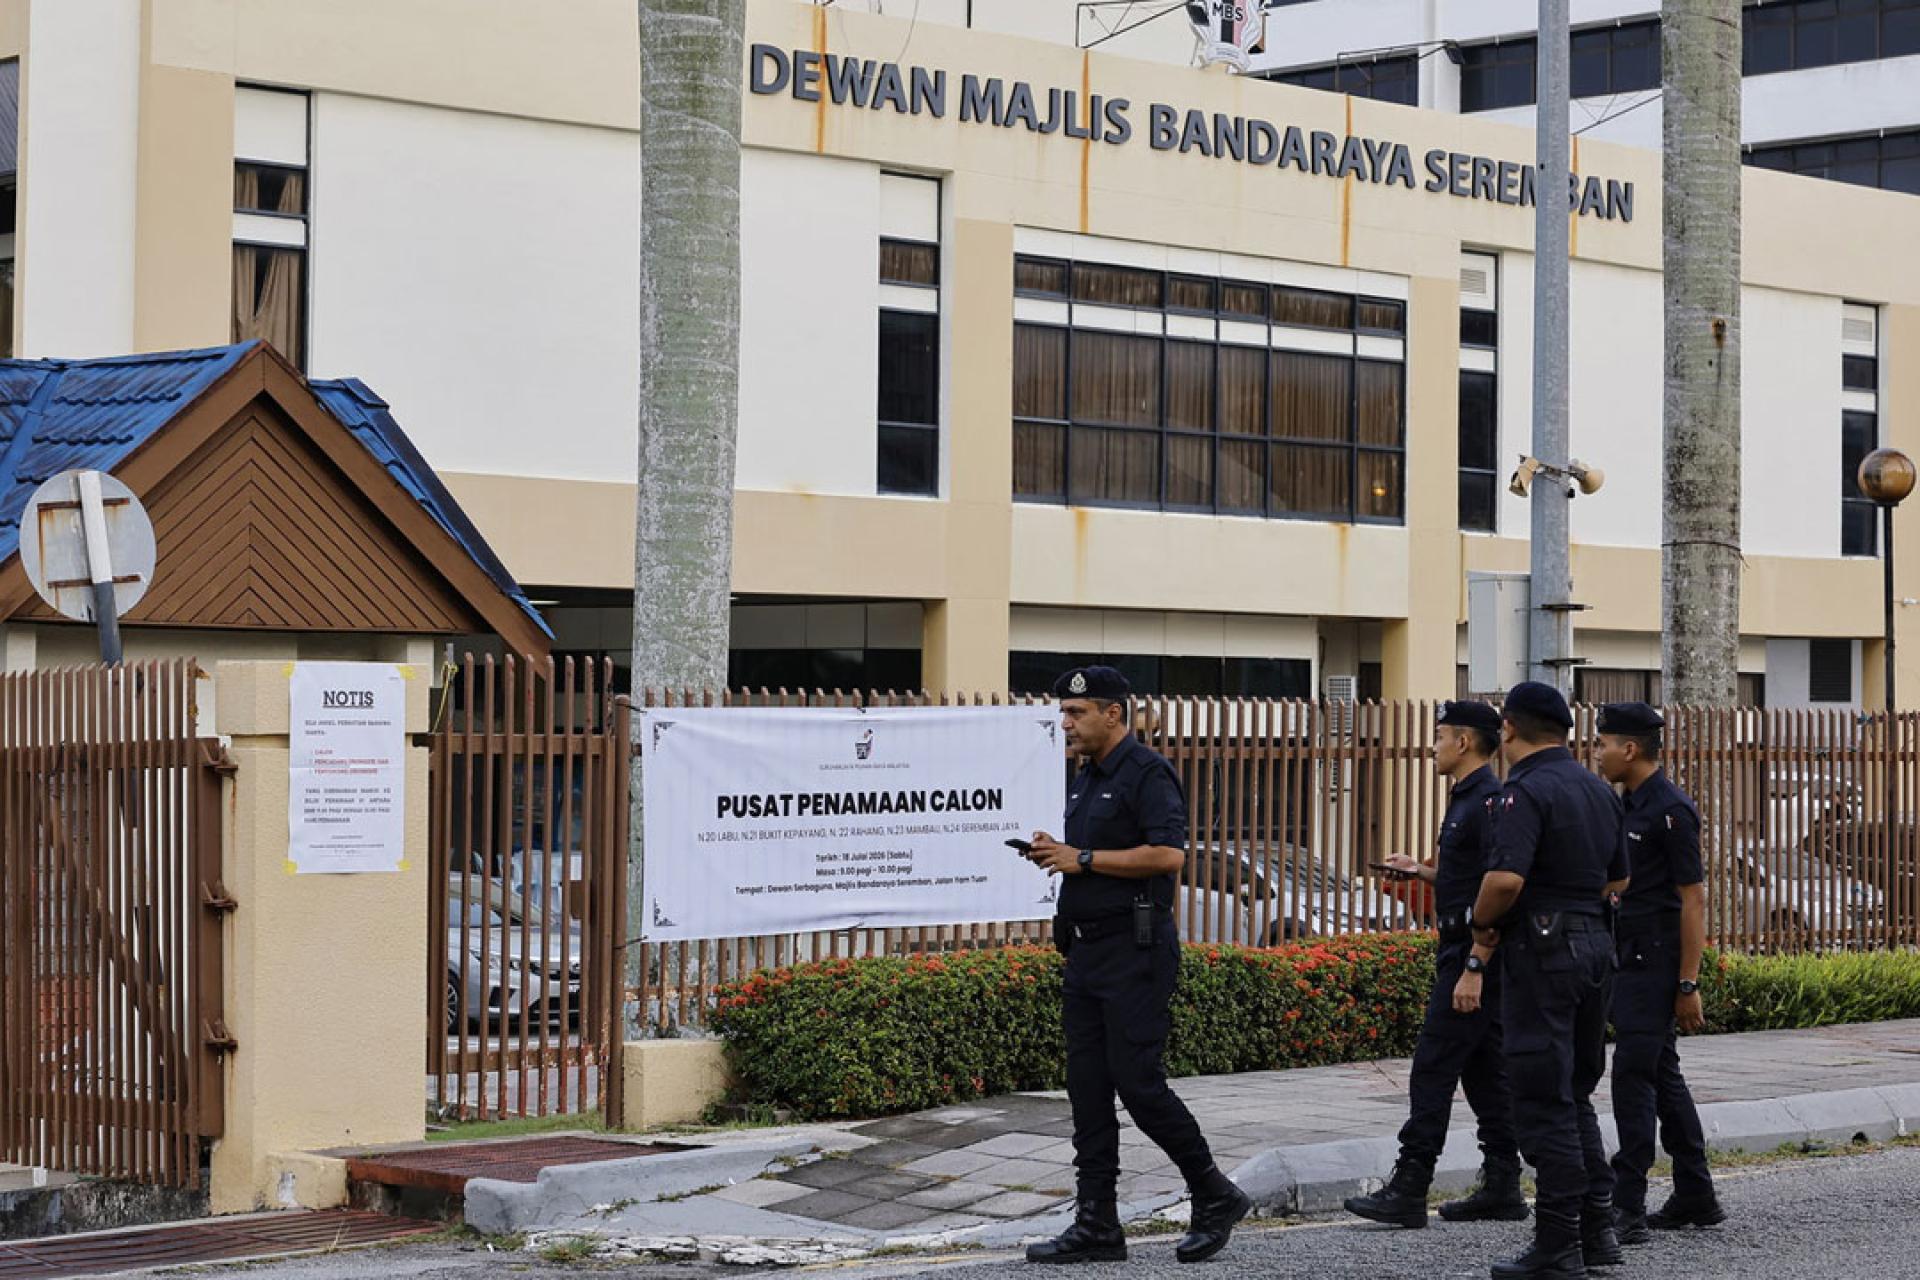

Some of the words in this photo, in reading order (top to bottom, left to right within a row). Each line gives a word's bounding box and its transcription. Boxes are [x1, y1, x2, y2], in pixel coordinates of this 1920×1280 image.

[1213, 2, 1244, 22] MBS
[750, 43, 947, 118] DEWAN
[960, 73, 1131, 145] MAJLIS
[1149, 103, 1416, 189] BANDARAYA
[323, 690, 374, 707] NOTIS
[716, 793, 793, 819] PUSAT
[797, 790, 926, 816] PENAMAAN
[930, 788, 1003, 812] CALON
[758, 830, 781, 840] BUKIT
[961, 822, 1000, 833] SEREMBAN
[1001, 821, 1019, 831] JAYA
[856, 866, 871, 877] pagi
[897, 864, 912, 875] pagi
[767, 885, 792, 893] Dewan
[835, 880, 855, 891] Majlis
